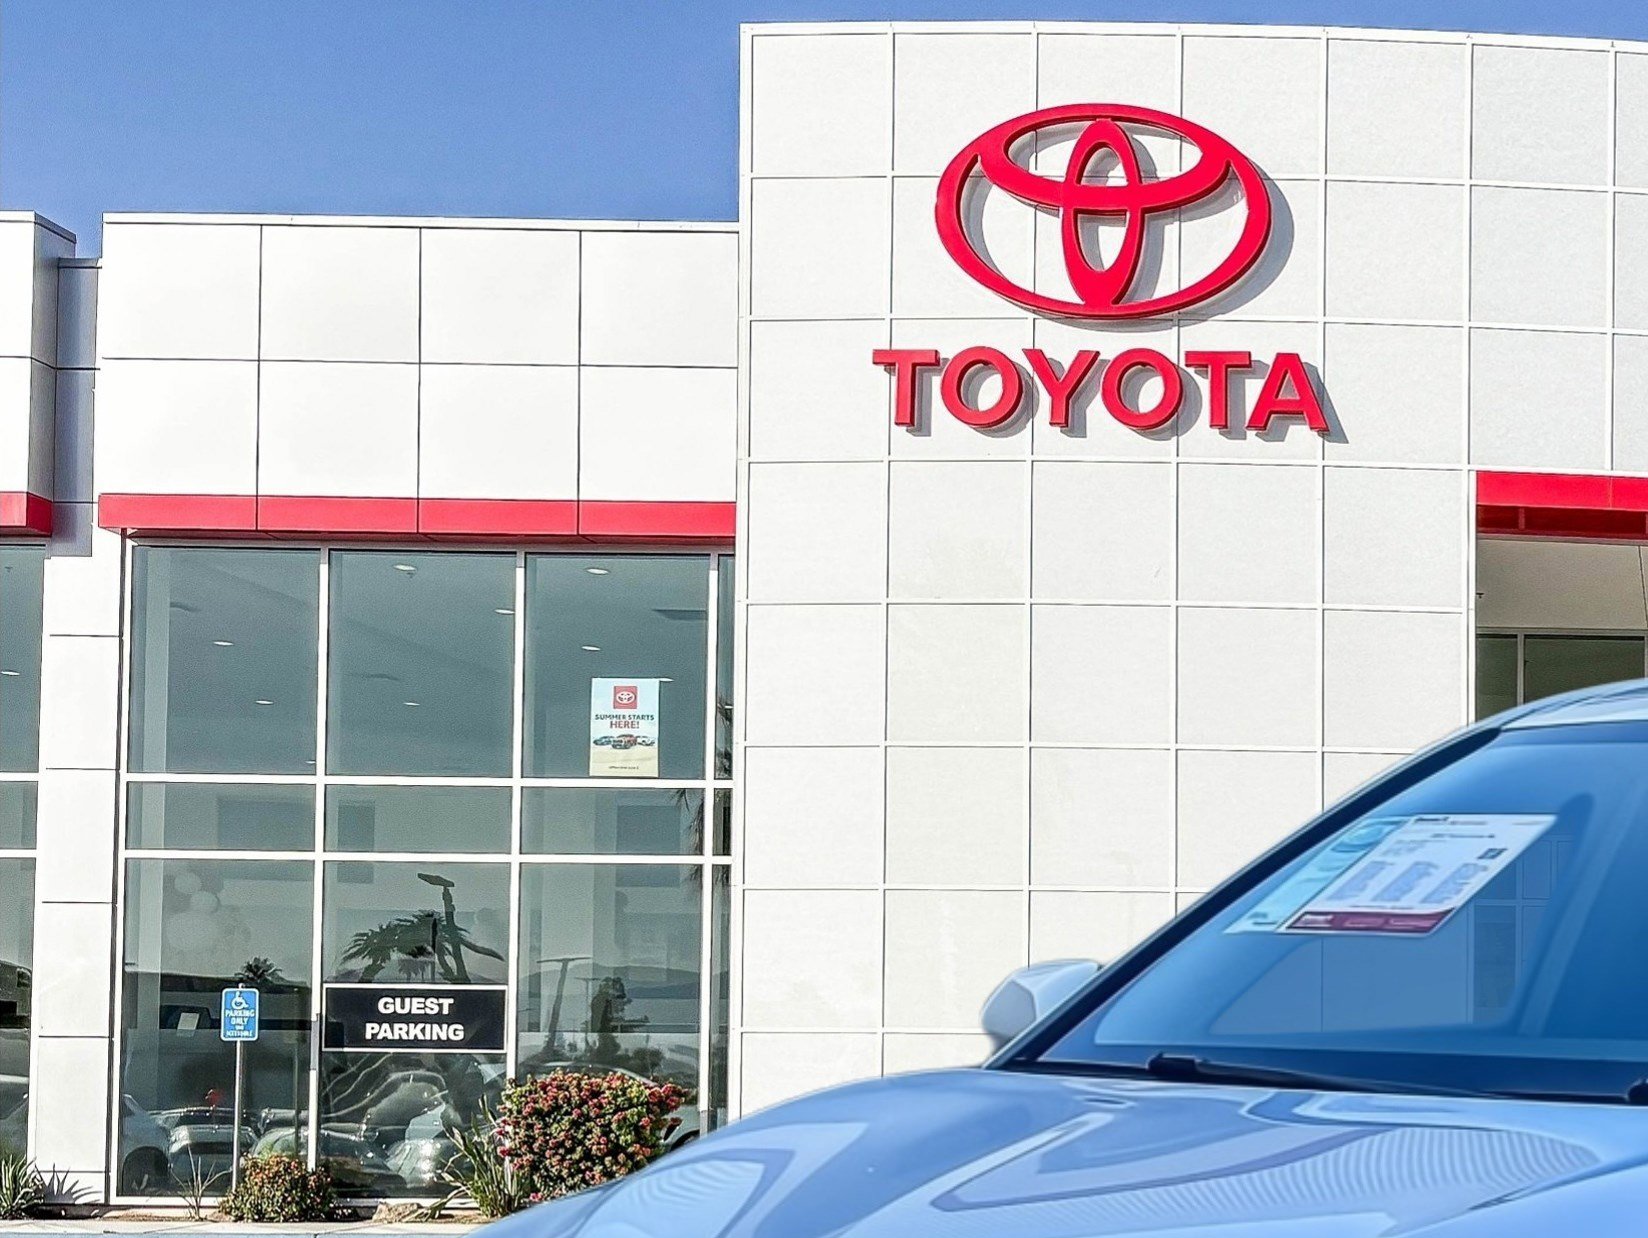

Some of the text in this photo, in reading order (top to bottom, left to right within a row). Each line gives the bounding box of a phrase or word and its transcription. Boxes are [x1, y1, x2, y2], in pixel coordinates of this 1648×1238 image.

[872, 346, 1329, 431] TOYOTA
[609, 720, 640, 729] HERE!
[378, 997, 454, 1015] GUEST
[365, 1023, 465, 1041] PARKING
